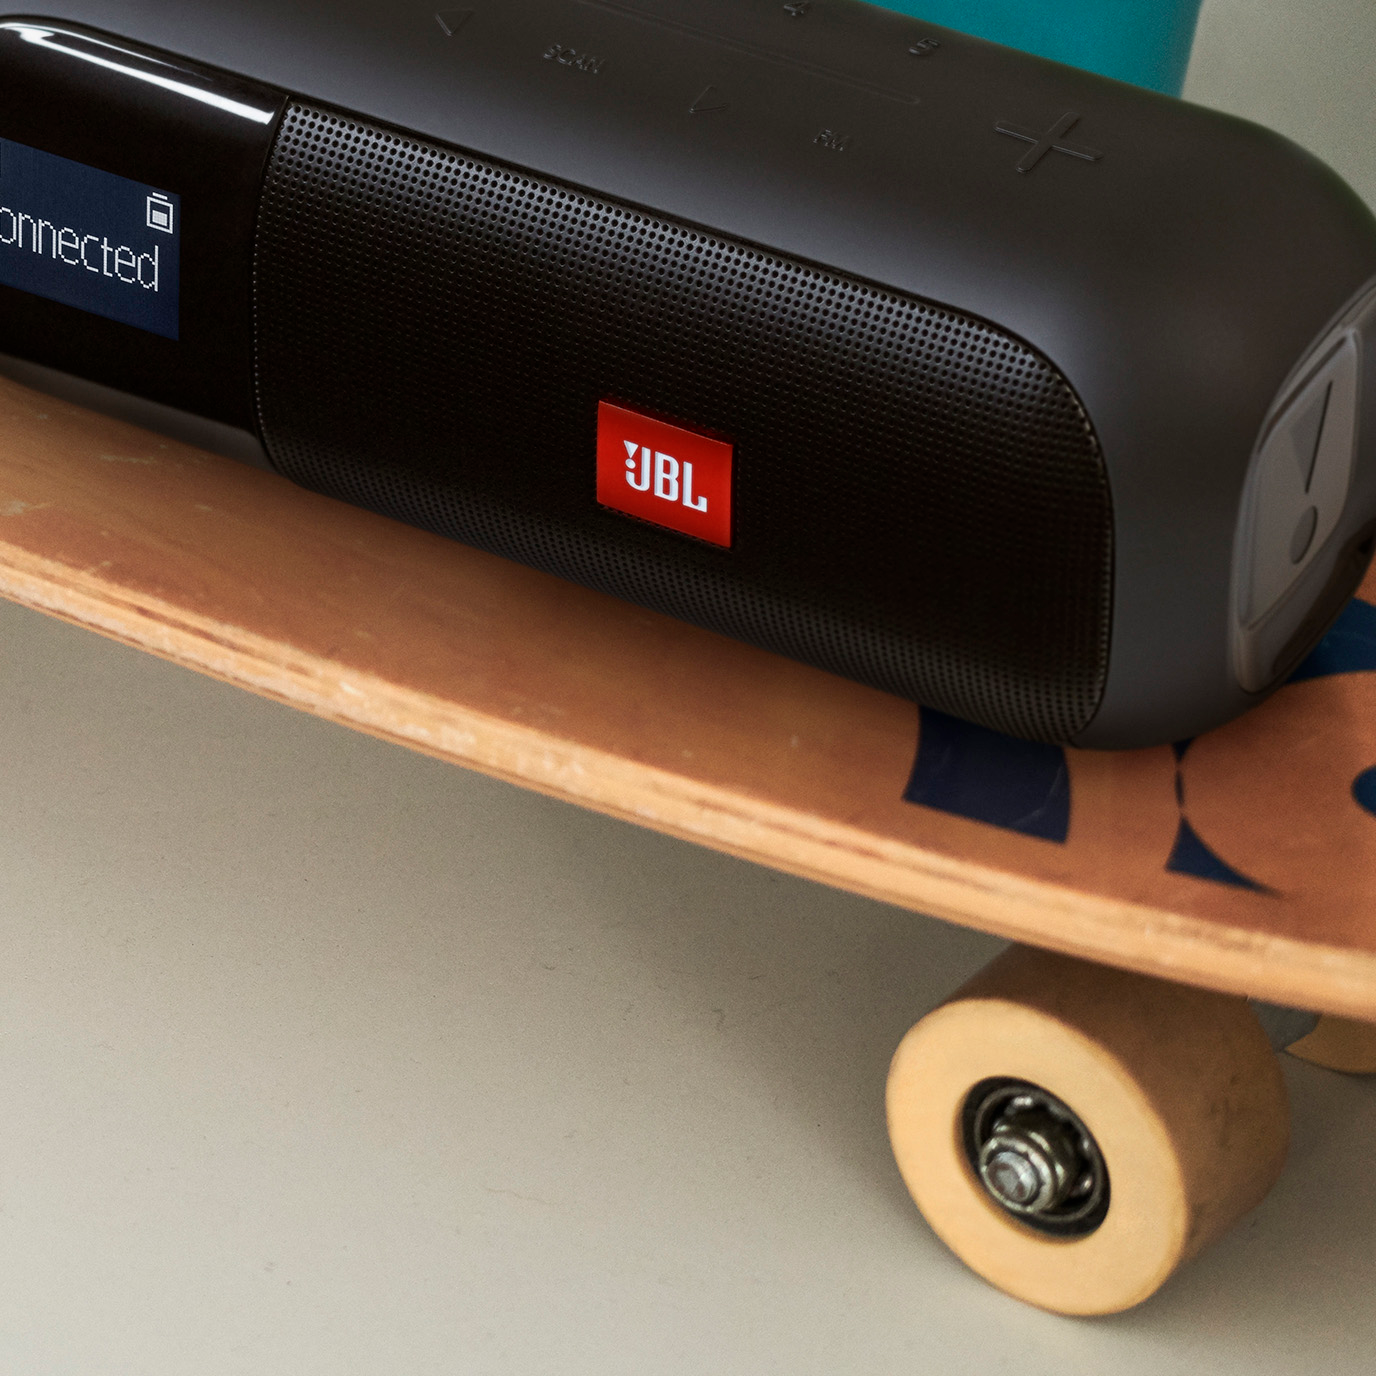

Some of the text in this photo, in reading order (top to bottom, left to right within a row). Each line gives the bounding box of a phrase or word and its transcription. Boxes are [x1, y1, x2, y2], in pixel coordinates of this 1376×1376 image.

[908, 36, 939, 55] 5
[543, 44, 606, 75] SCAN
[812, 128, 850, 152] FM
[623, 439, 708, 513] JBL
